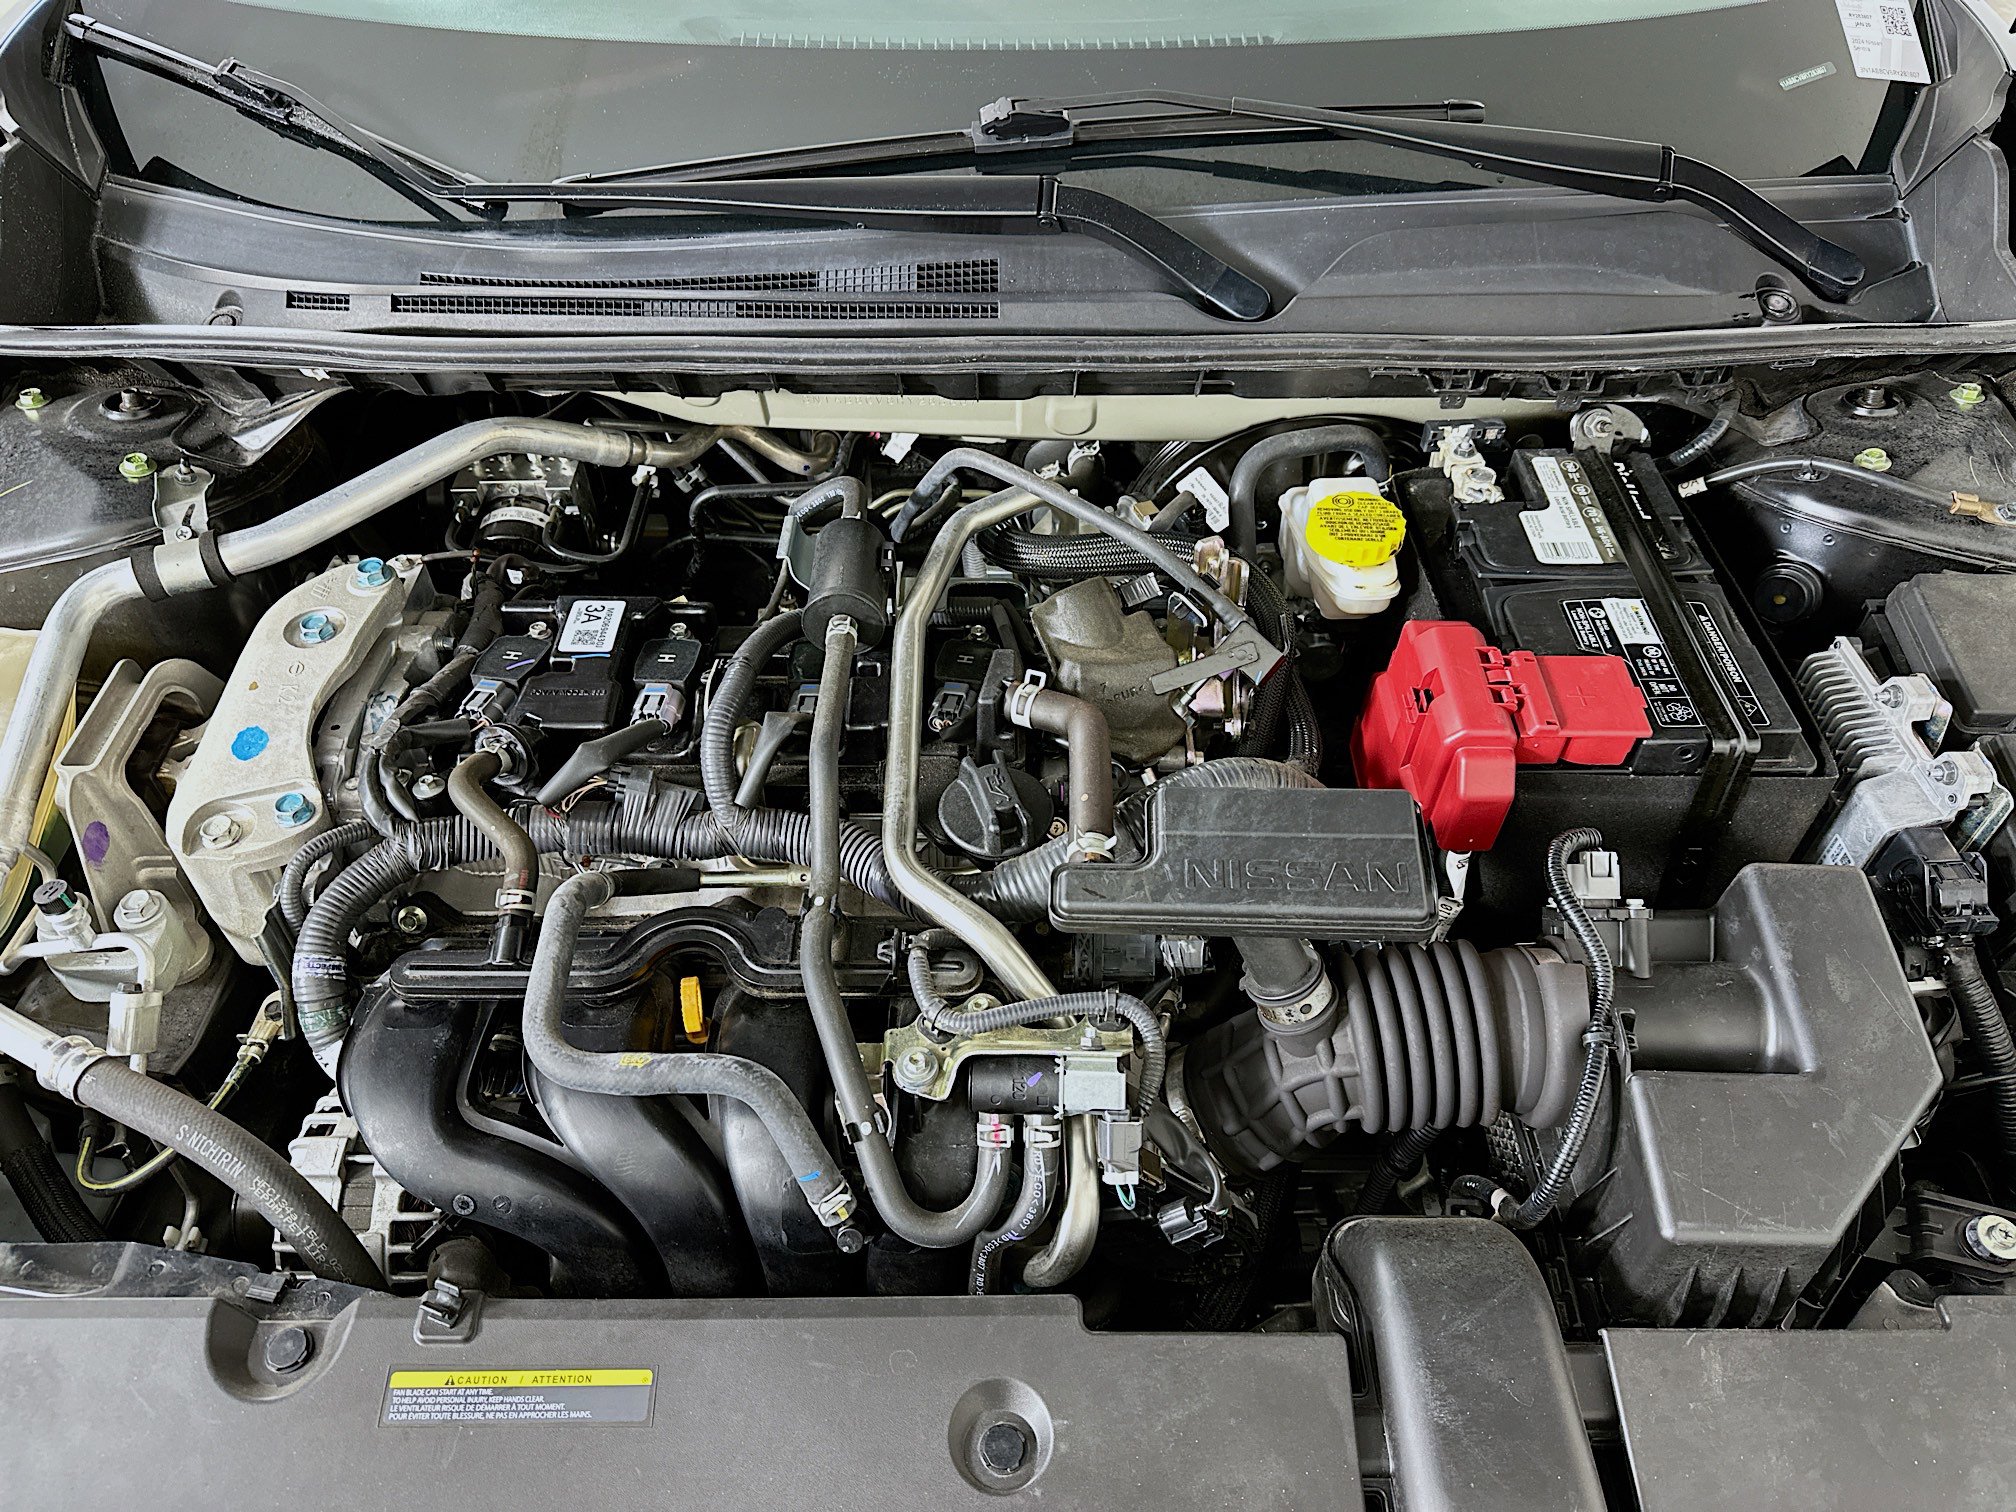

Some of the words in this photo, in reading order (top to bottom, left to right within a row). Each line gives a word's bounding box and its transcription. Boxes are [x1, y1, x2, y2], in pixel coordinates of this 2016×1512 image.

[581, 605, 605, 624] 3A
[1702, 621, 1742, 684] DANGER/POISON
[1184, 858, 1410, 892] NISSAN
[457, 1376, 507, 1384] CAUTION
[532, 1375, 592, 1383] ATTENTION
